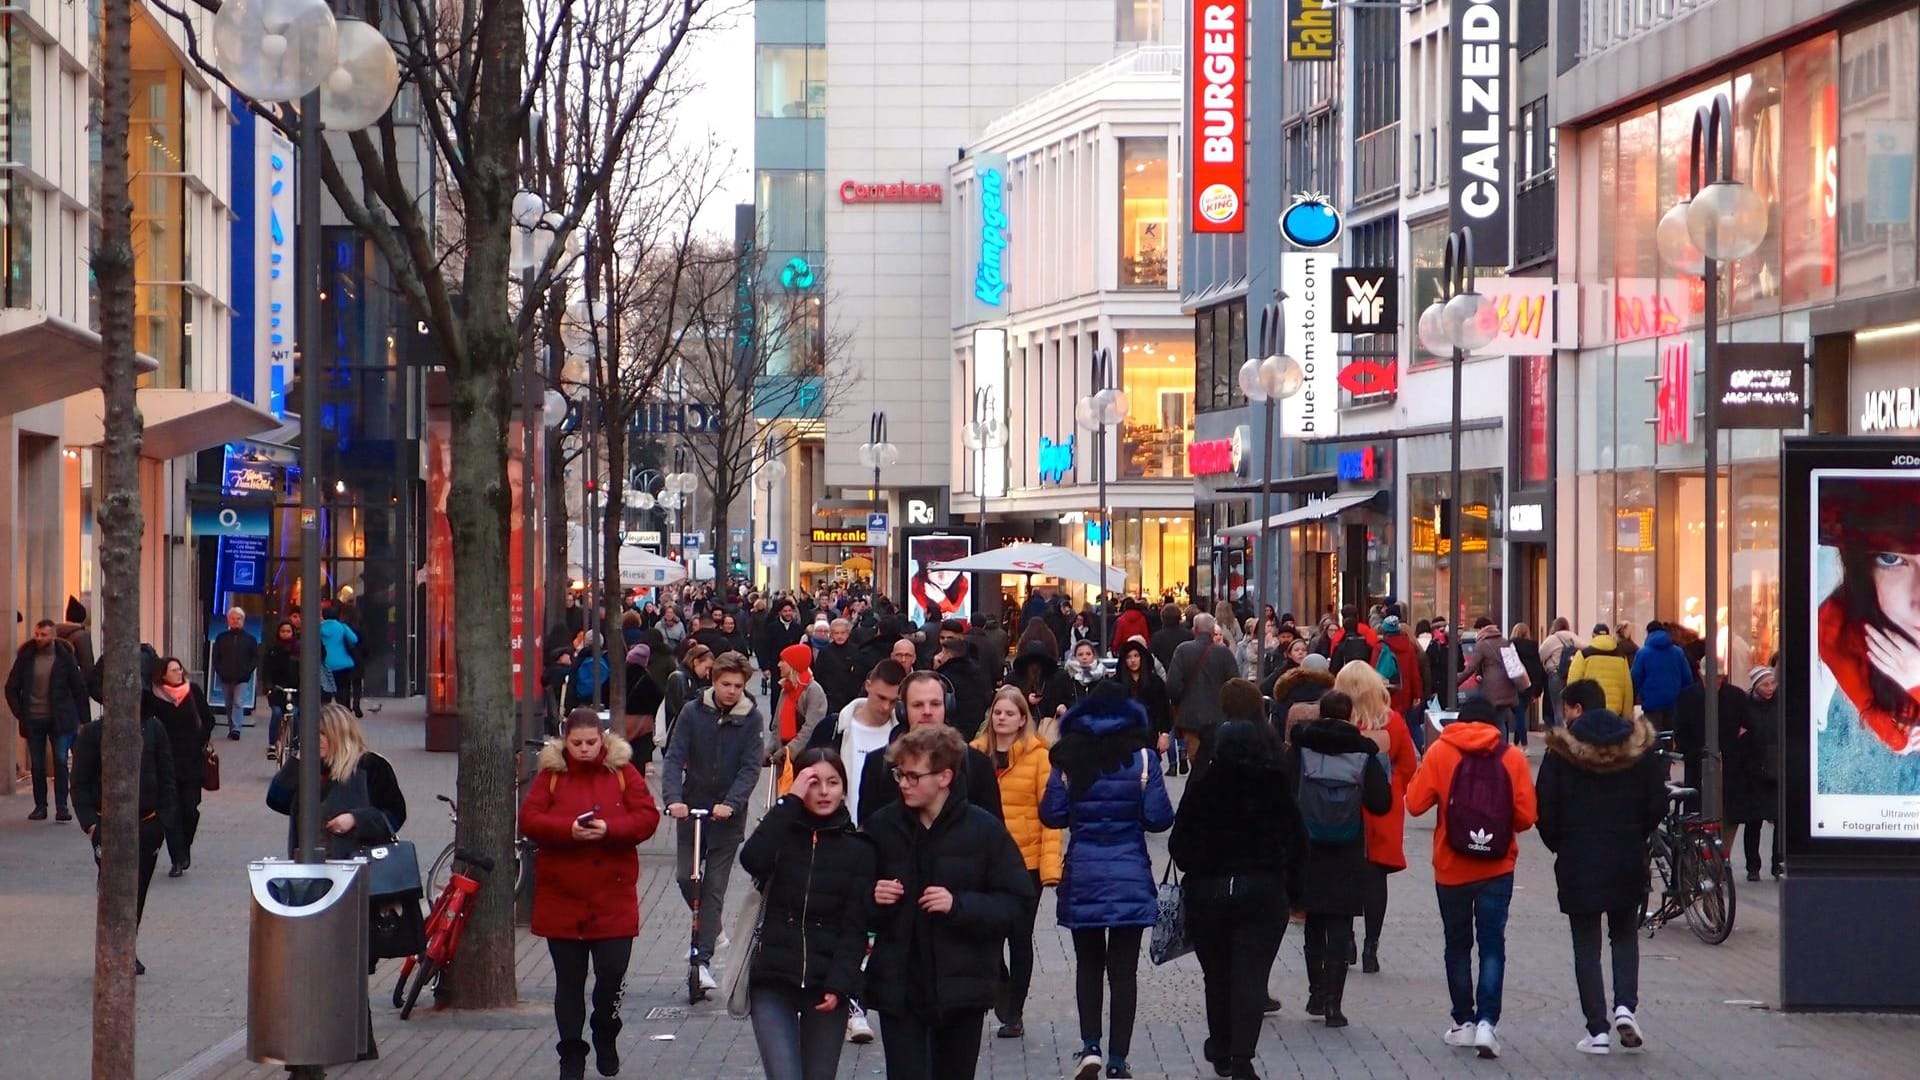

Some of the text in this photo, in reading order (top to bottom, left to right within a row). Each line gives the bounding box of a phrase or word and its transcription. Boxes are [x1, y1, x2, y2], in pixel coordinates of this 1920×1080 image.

[1203, 4, 1235, 163] BURGER
[1461, 0, 1500, 219] CALZED
[840, 180, 943, 205] Cornelsen
[1206, 200, 1234, 212] KING
[976, 168, 1007, 307] Kämpgen
[1486, 293, 1546, 338] &M
[1302, 257, 1316, 433] blue-tomato.com
[1467, 843, 1492, 851] adidas
[1842, 821, 1920, 832] Fotografiert mit
